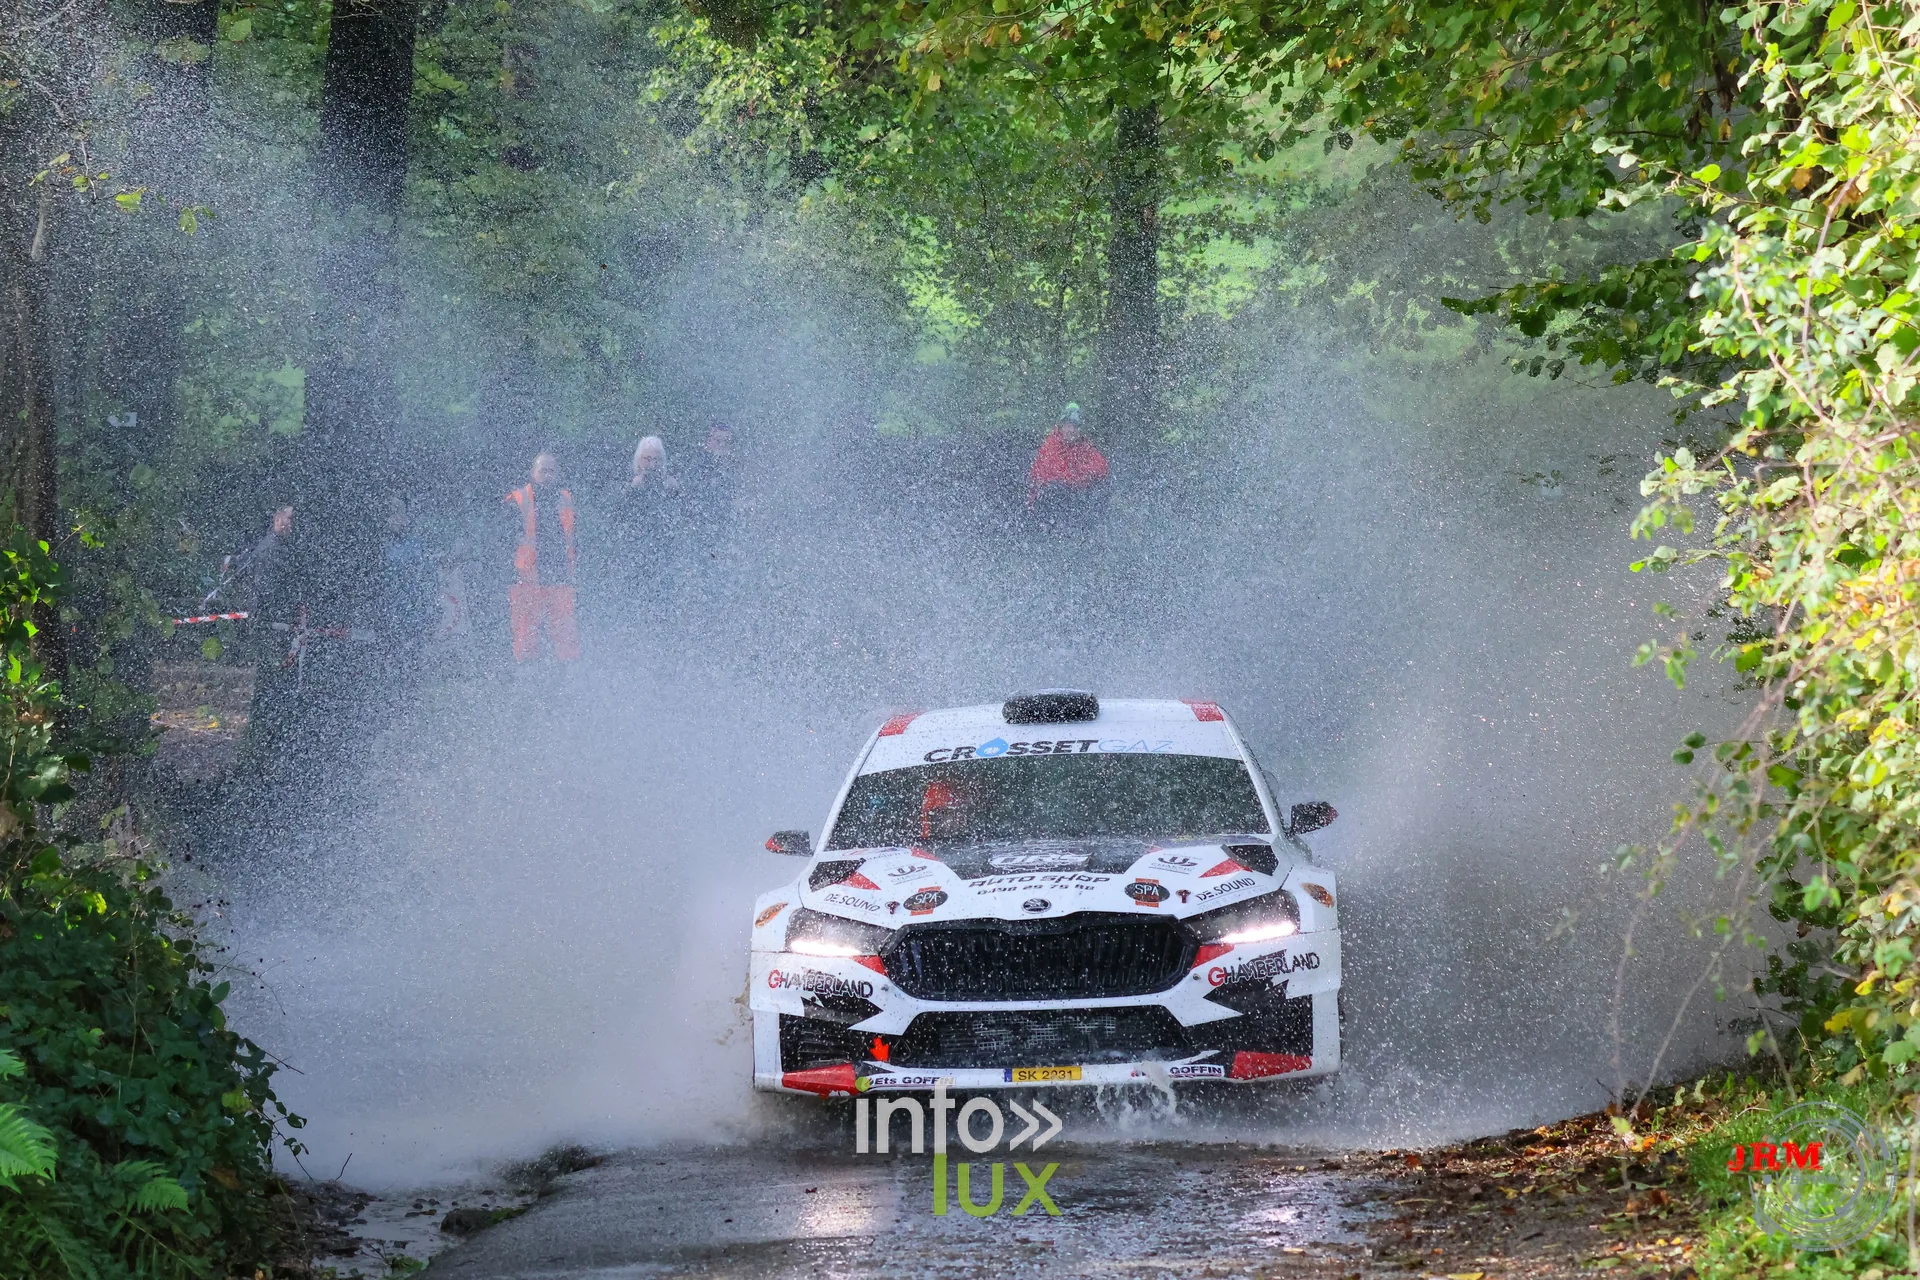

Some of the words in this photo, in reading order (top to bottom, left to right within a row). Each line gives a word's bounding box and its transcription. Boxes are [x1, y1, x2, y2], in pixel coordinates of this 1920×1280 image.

[968, 875, 1036, 887] AUTO
[1040, 873, 1110, 884] SHOP
[1134, 883, 1160, 897] SPA
[1196, 877, 1256, 902] DE.SOUND
[914, 892, 938, 905] SPA
[1018, 1070, 1037, 1081] SK
[1169, 1066, 1222, 1075] GOFFIN
[875, 1077, 896, 1085] Ets
